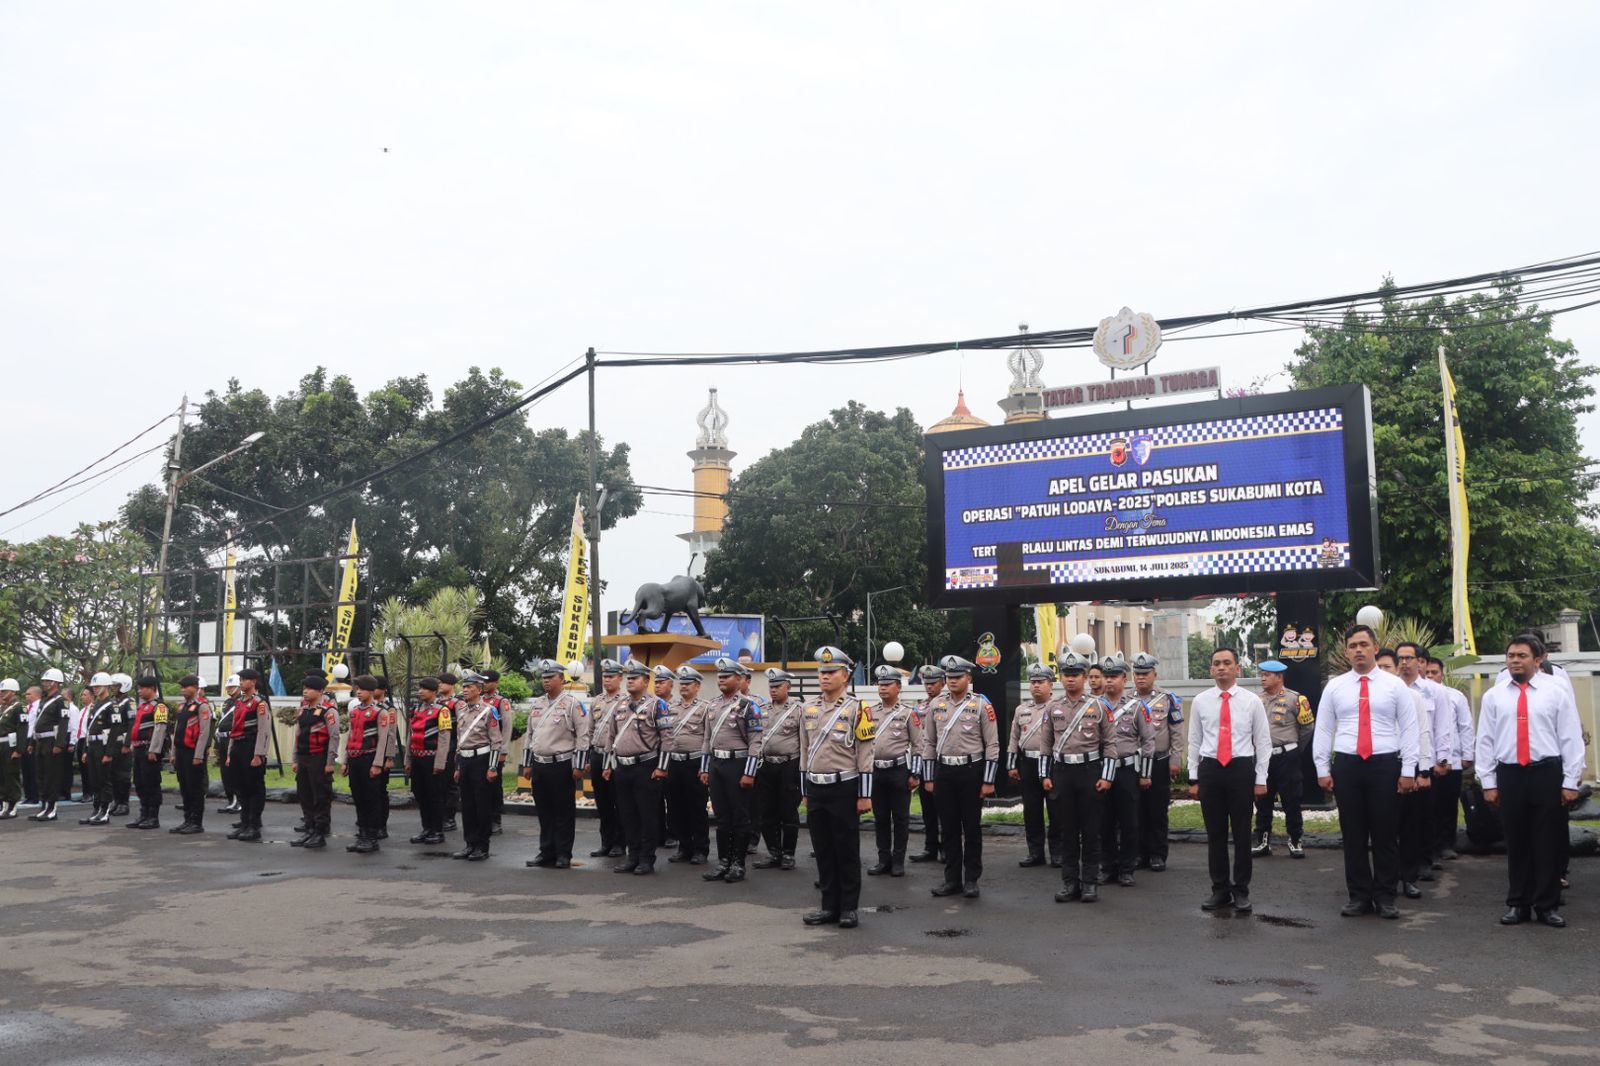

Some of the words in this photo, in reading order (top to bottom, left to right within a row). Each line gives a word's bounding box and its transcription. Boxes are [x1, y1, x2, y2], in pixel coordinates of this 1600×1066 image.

[1042, 386, 1083, 407] TATAG
[1087, 377, 1156, 401] TRAWANG
[1160, 369, 1218, 393] TUNGGA
[1048, 477, 1086, 496] APEL
[1089, 472, 1138, 492] GELAR
[1141, 464, 1218, 487] PASUKAN
[962, 506, 1013, 523] OPERASI
[1015, 502, 1061, 519] "PATUH
[1209, 483, 1282, 503] SUKABUMI
[1285, 480, 1323, 497] KOTA
[972, 545, 997, 558] TERT
[1022, 541, 1054, 555] RLALU
[1056, 538, 1093, 552] LINTAS
[1095, 537, 1124, 550] DEMI
[1126, 529, 1209, 547] TERWUJUDNYA
[1211, 525, 1276, 541] INDONESIA
[1279, 522, 1314, 537] EMAS
[1104, 516, 1138, 533] Dengan
[1140, 512, 1167, 529] Tema
[1094, 564, 1138, 574] SUKABUMI,
[1150, 562, 1168, 571] JULI
[1170, 561, 1189, 570] 2025
[565, 594, 583, 662] SUKABUM
